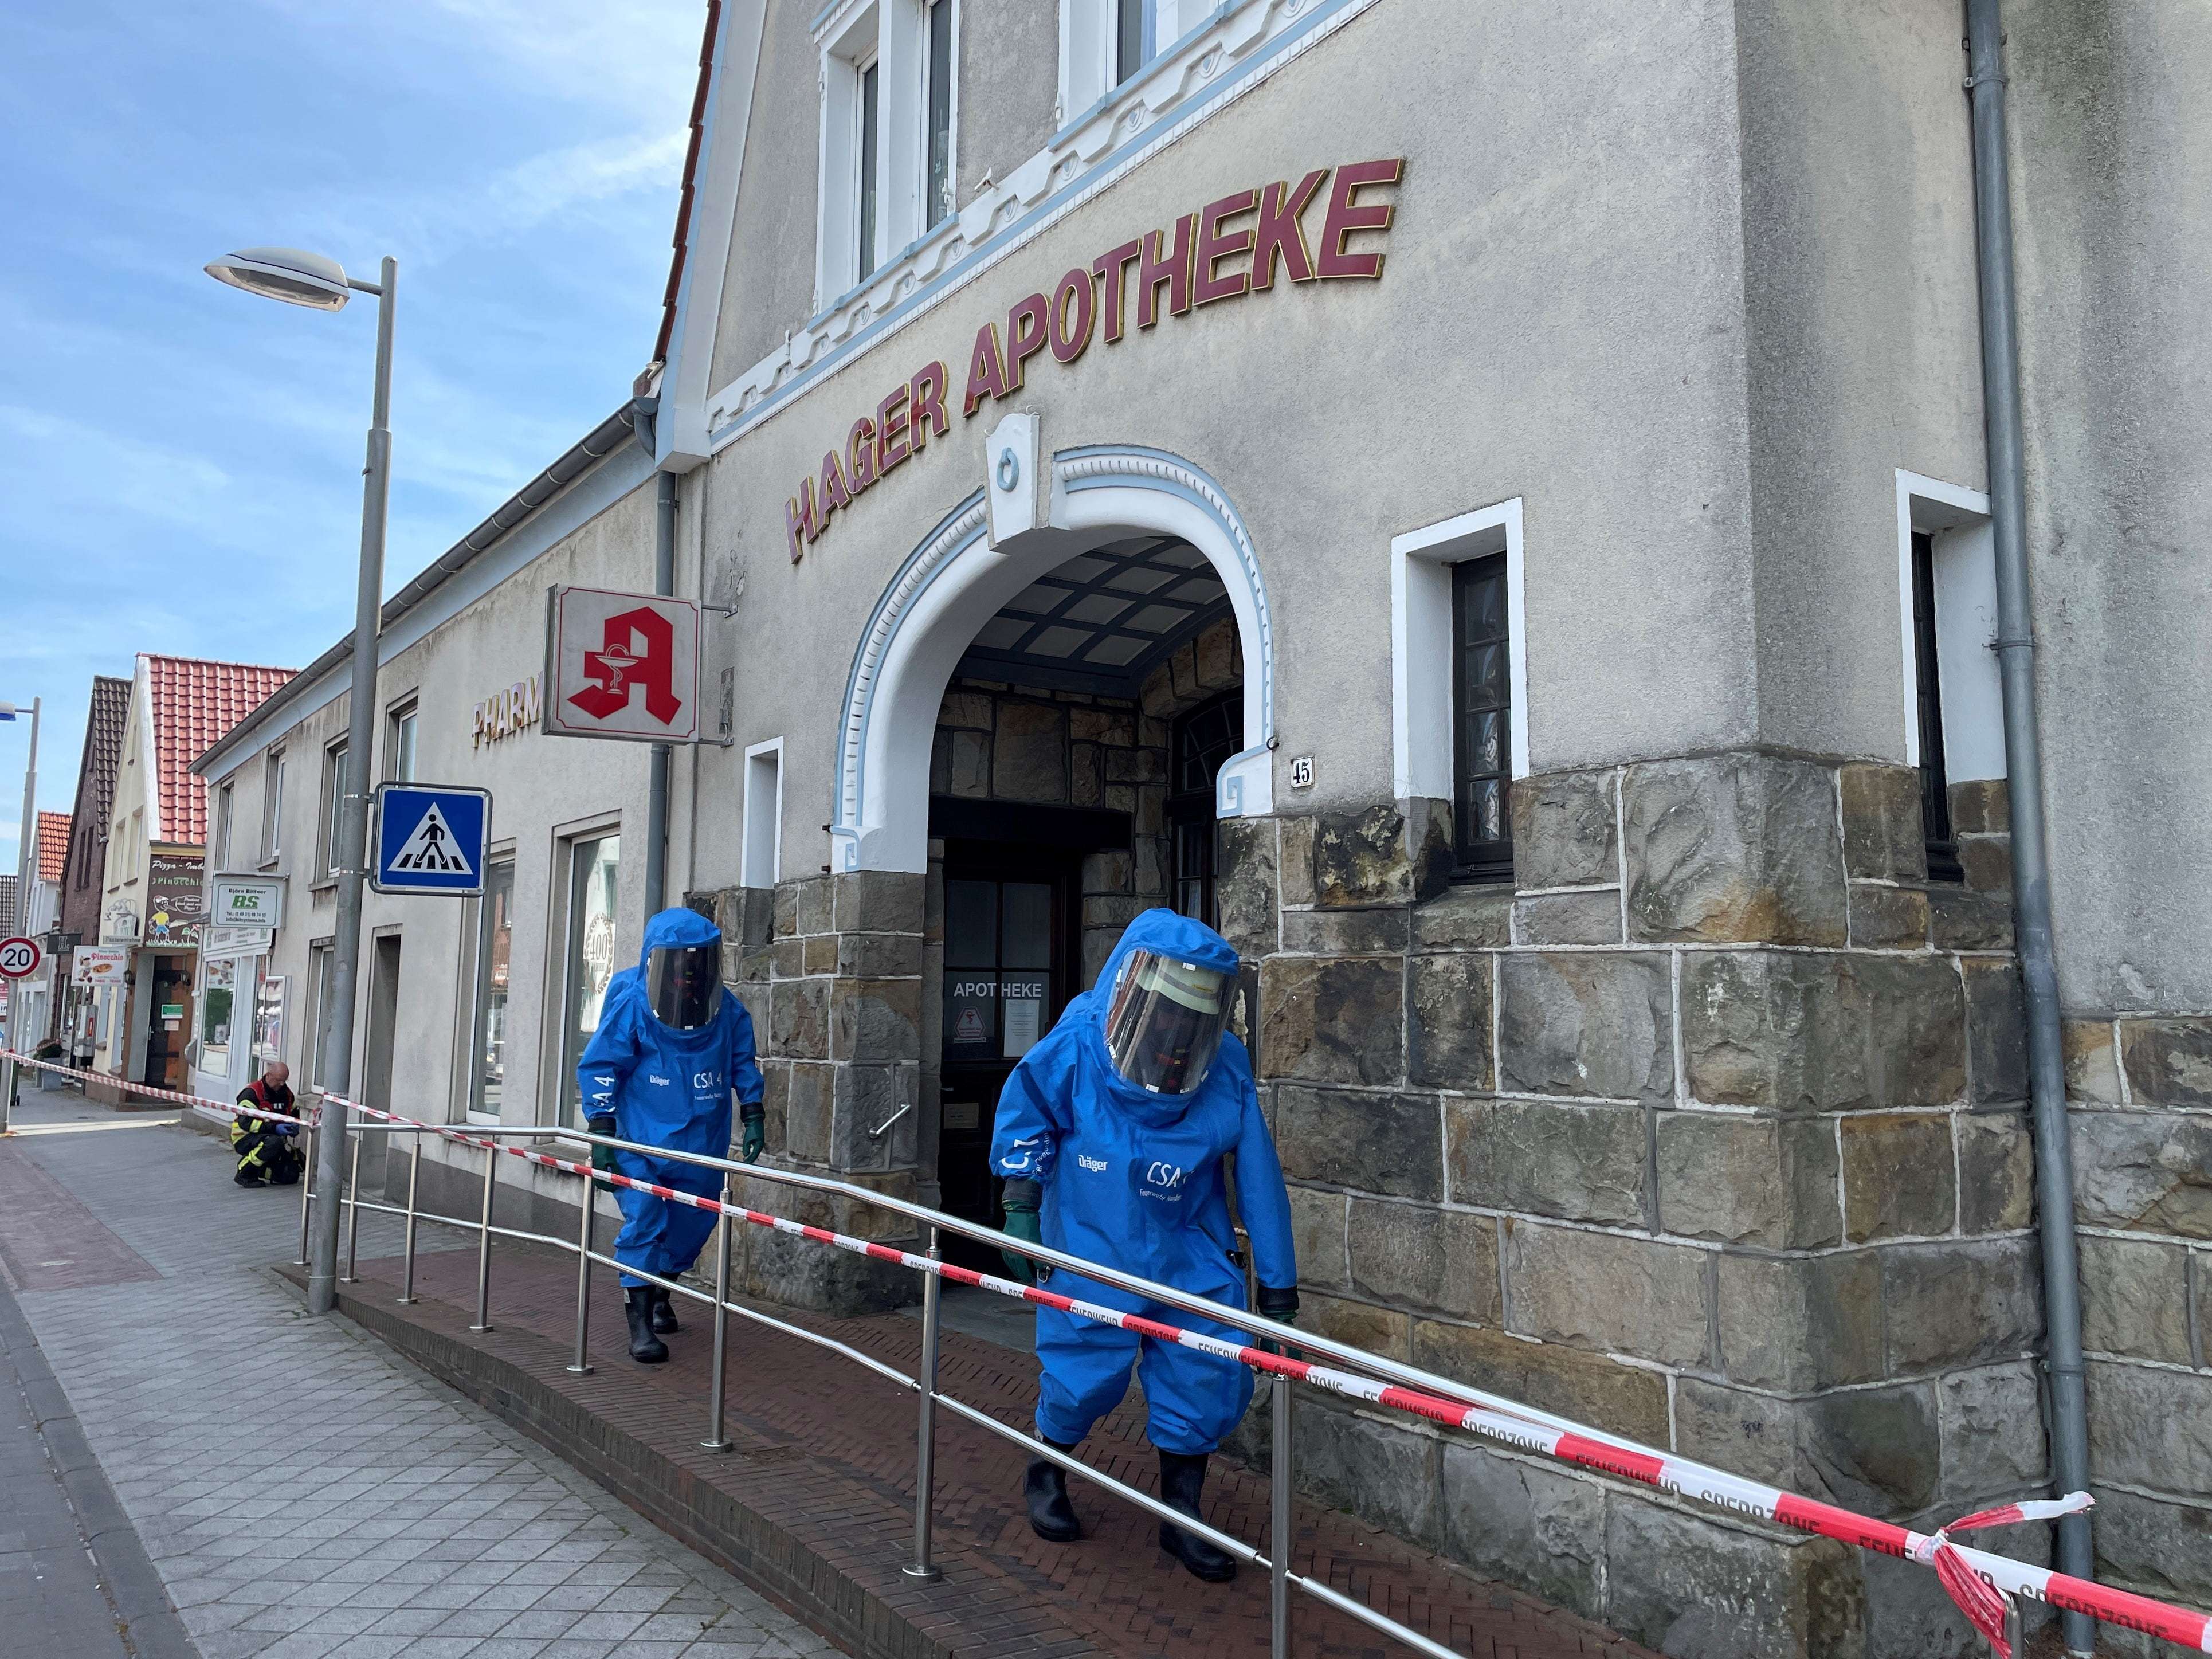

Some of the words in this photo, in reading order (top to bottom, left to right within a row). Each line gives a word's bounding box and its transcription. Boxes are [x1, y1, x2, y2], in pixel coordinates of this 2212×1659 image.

[783, 360, 950, 564] HAGER
[962, 158, 1406, 418] APOTHEKE
[1293, 761, 1310, 784] 45
[152, 860, 176, 871] Pizza
[590, 934, 607, 960] 400
[4, 948, 30, 967] 20
[91, 953, 124, 961] Pinocchio
[650, 1075, 670, 1087] Dräger
[694, 1075, 713, 1089] CSA
[1078, 1154, 1108, 1172] Dräger
[1147, 1162, 1180, 1188] CSA
